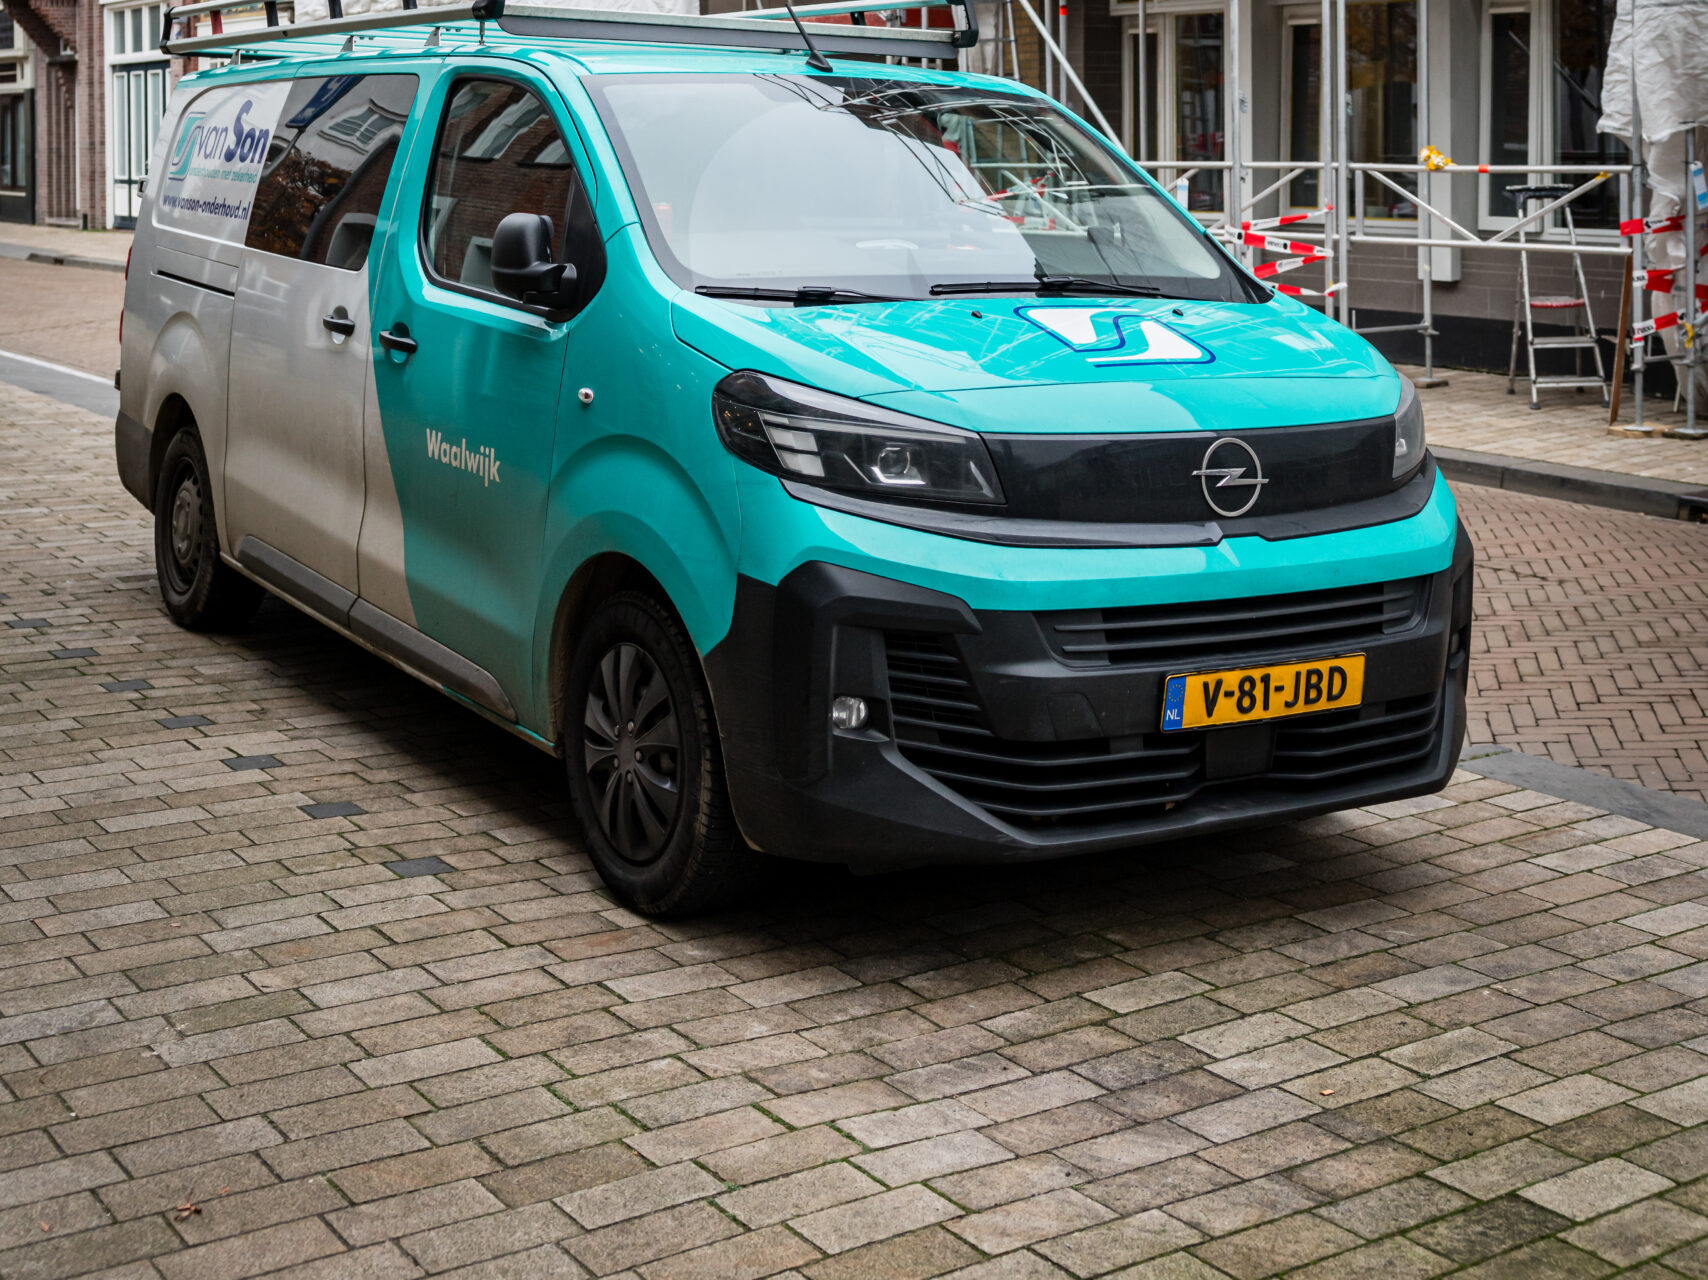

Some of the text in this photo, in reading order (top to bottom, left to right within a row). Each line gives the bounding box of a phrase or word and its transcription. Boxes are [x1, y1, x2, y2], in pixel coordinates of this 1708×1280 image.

[224, 99, 270, 164] Son
[162, 194, 252, 220] www.vanson-onderhoud.nl
[426, 427, 501, 488] Waalwijk
[1166, 709, 1181, 720] NL
[1203, 665, 1348, 718] V-81-JBD
